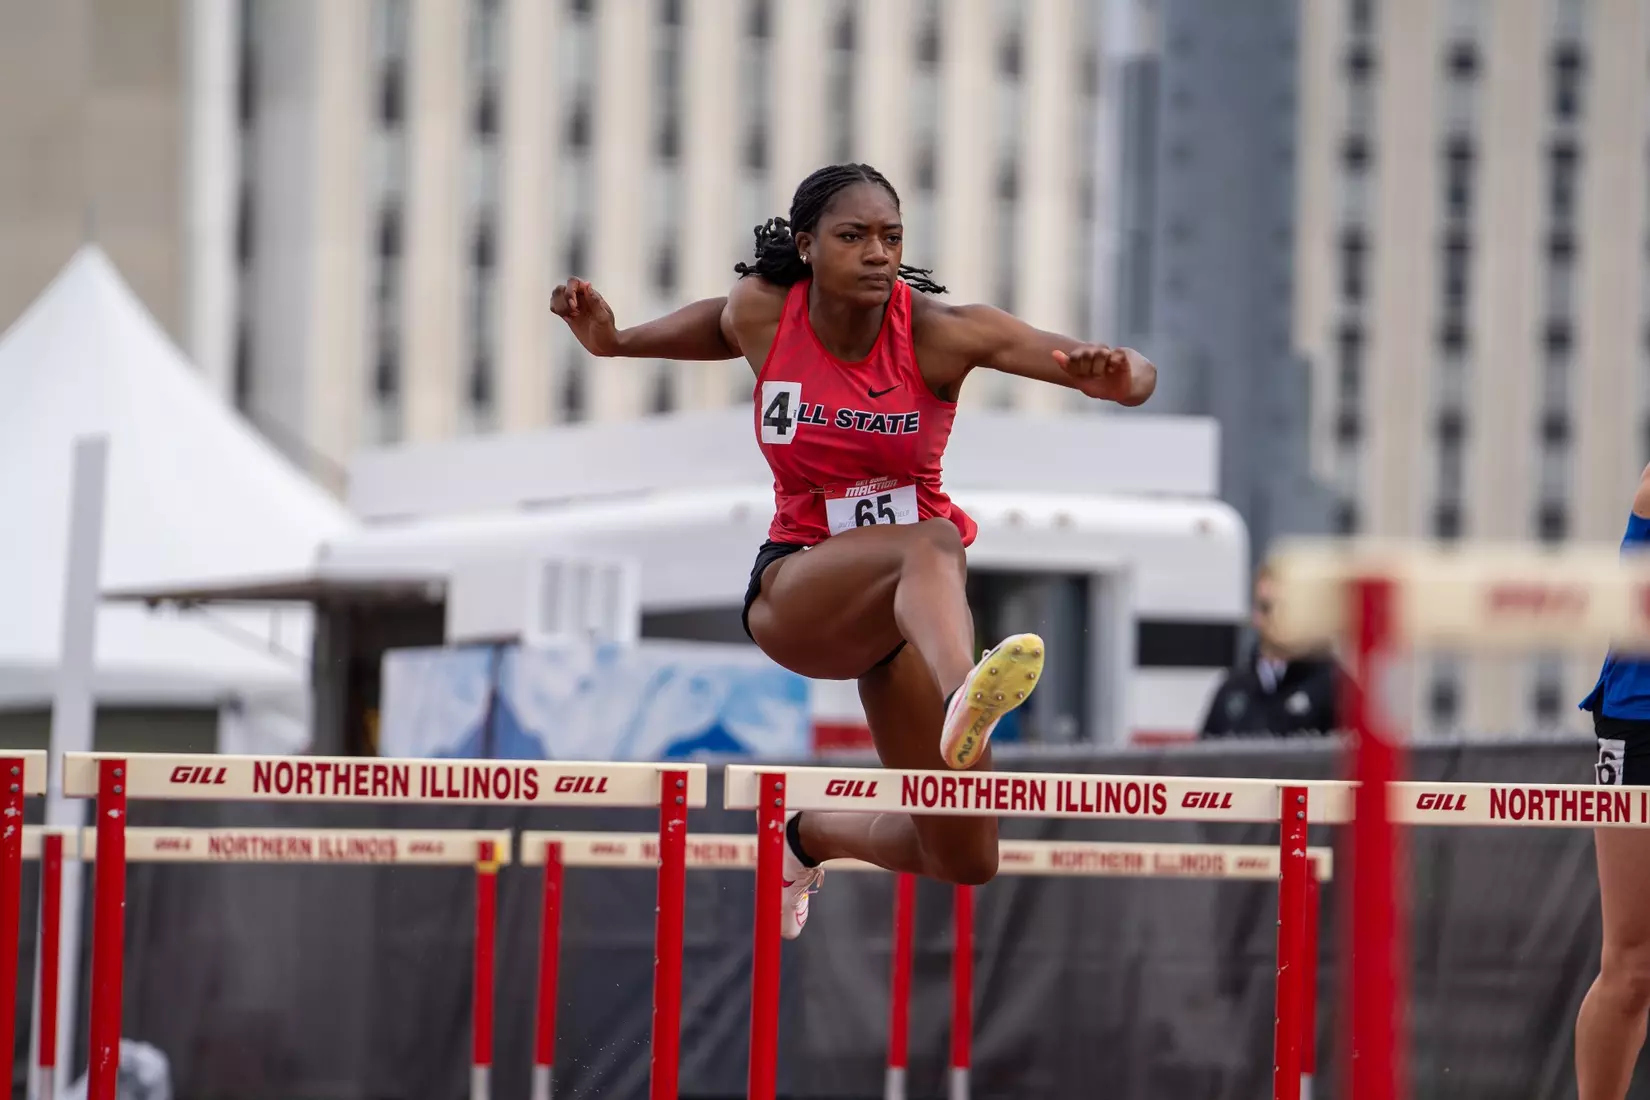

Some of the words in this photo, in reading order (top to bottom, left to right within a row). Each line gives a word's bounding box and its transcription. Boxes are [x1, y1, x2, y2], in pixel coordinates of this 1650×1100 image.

[763, 392, 792, 435] 4
[797, 403, 828, 426] LL
[835, 407, 919, 435] STATE
[855, 494, 896, 527] 65
[170, 766, 227, 784] GILL
[253, 761, 409, 797] NORTHERN
[421, 766, 539, 800] ILLINOIS
[554, 776, 608, 793] GILL
[825, 779, 878, 797] GILL
[901, 775, 1046, 811] NORTHERN
[1056, 780, 1167, 815] ILLINOIS
[1181, 792, 1233, 808] GILL
[1416, 793, 1467, 811] GILL
[1490, 788, 1631, 823] NORTHERN
